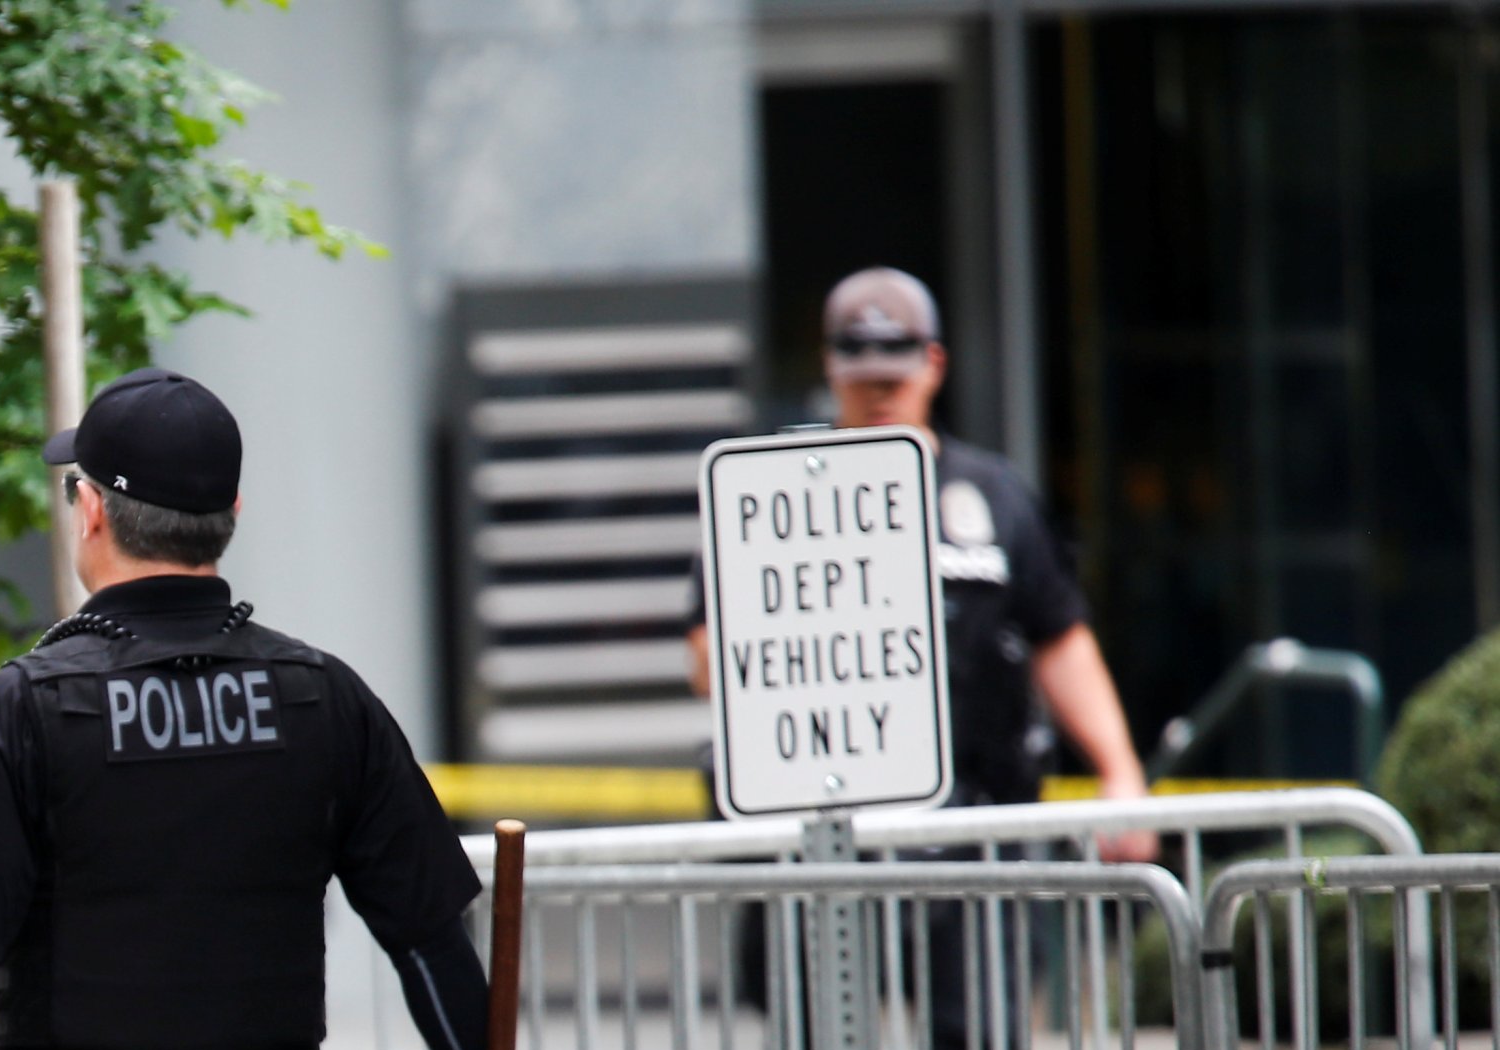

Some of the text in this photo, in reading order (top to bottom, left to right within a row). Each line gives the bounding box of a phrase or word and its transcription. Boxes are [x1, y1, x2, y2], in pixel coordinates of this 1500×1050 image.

[739, 480, 904, 542] POLICE
[762, 558, 891, 614] DEPT.
[733, 626, 924, 689] VEHICLES
[107, 669, 278, 752] POLICE
[777, 701, 890, 760] ONLY
